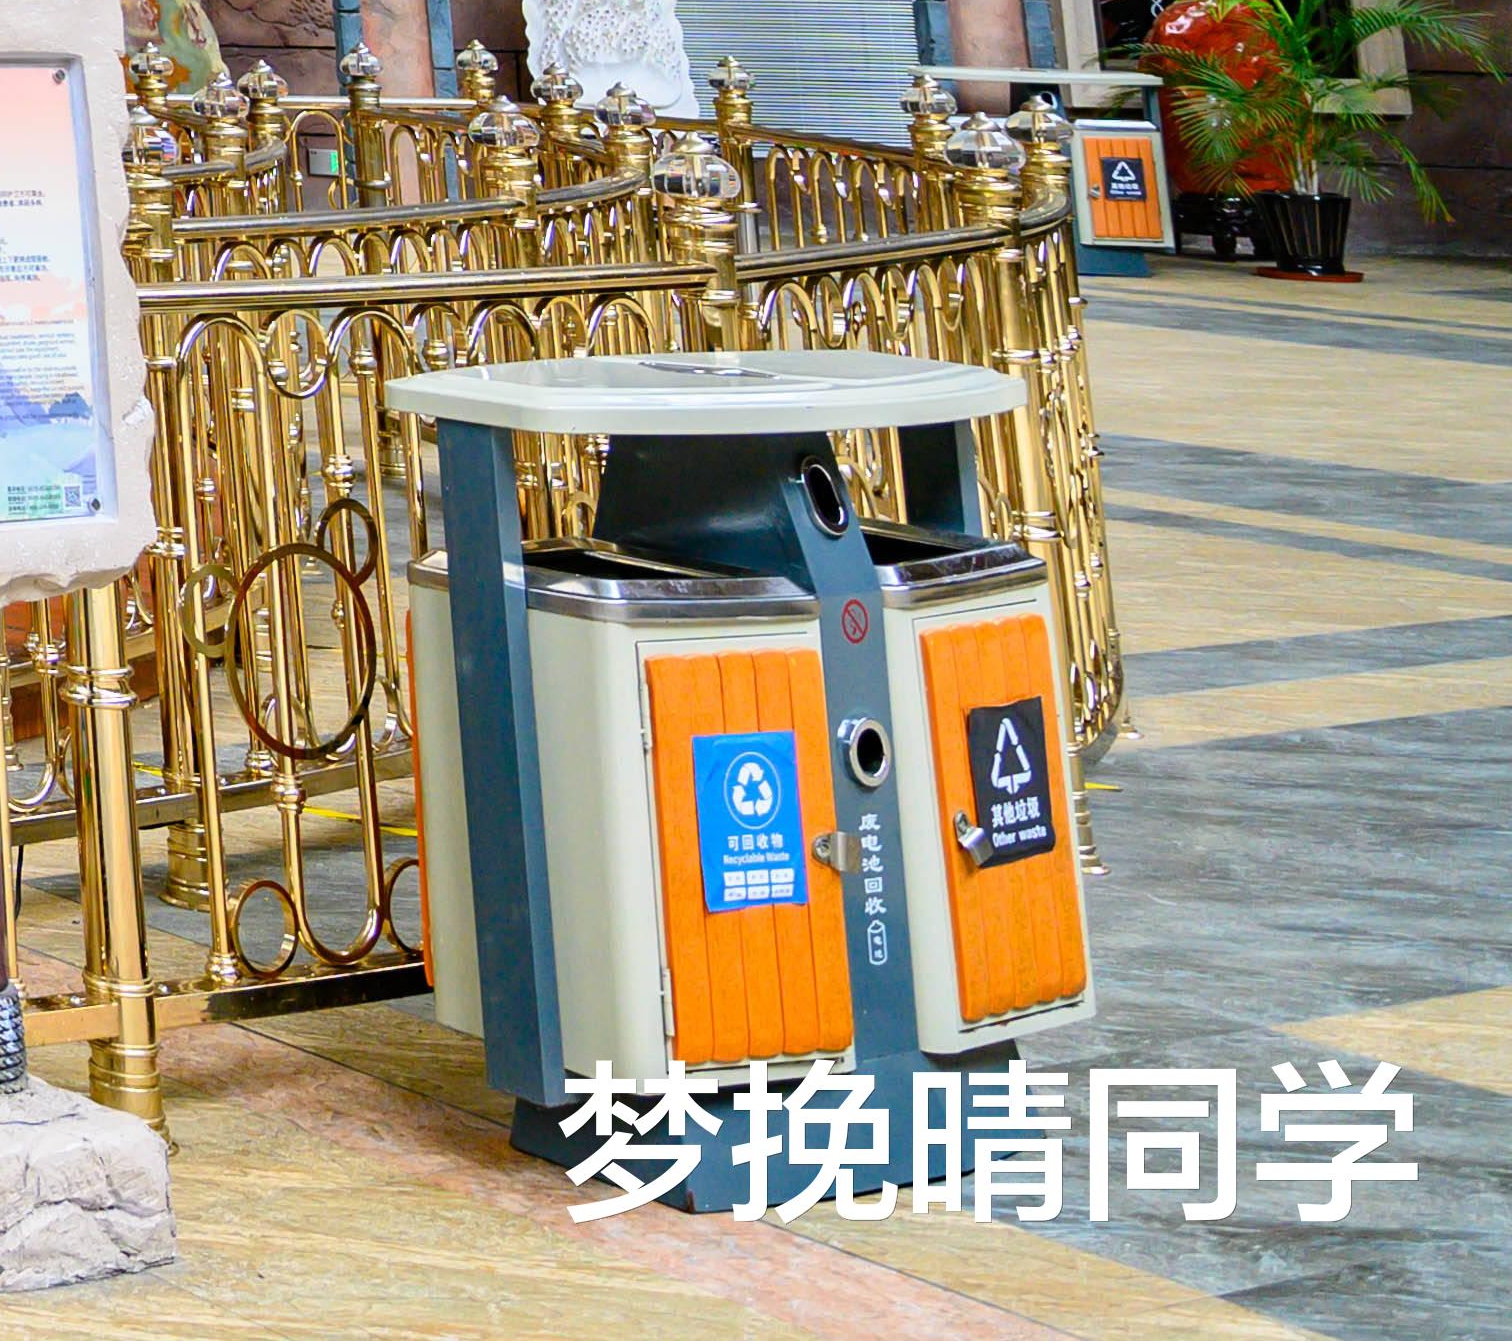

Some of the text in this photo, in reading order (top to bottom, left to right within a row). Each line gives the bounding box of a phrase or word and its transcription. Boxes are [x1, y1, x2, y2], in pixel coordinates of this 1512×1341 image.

[991, 796, 1040, 828] 其他垃圾
[727, 832, 783, 851] 可回收物
[992, 825, 1047, 848] Other waste
[858, 813, 887, 915] 废电池回收
